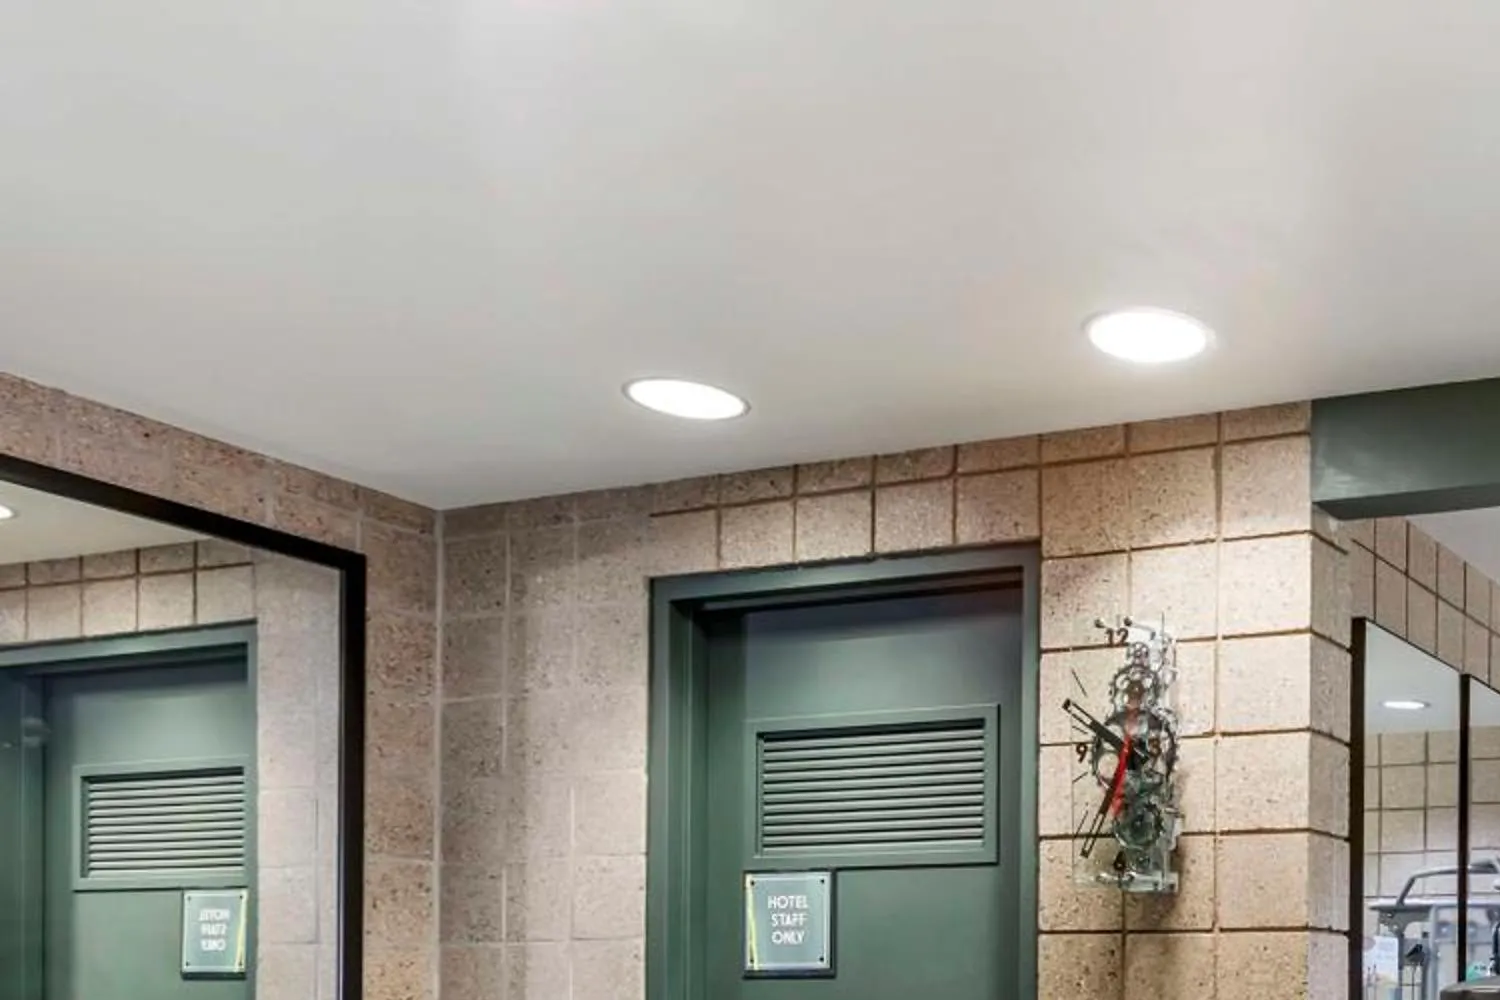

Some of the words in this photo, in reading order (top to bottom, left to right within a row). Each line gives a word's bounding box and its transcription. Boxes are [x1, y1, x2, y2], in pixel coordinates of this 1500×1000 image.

[1105, 627, 1129, 647] 12
[1076, 742, 1089, 763] 9
[767, 895, 809, 909] HOTEL
[771, 913, 808, 927] STAFF
[771, 931, 806, 945] ONLY
